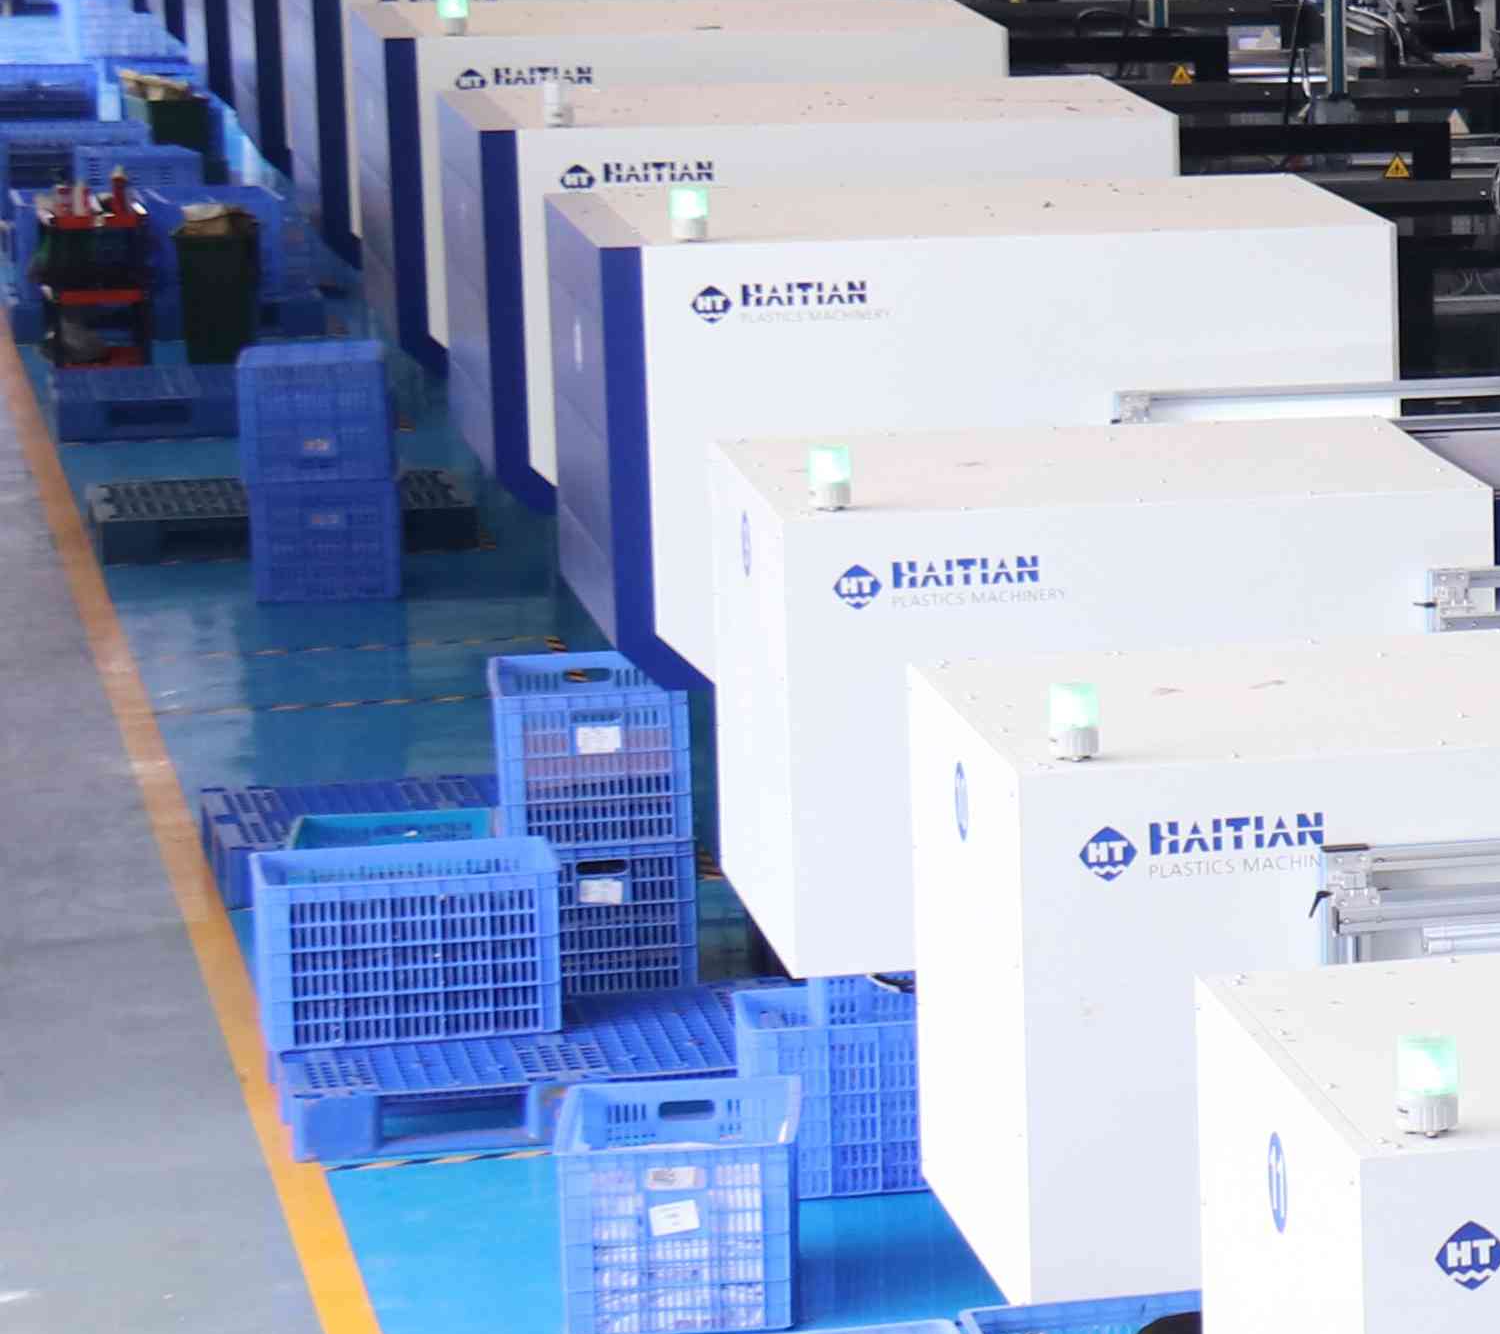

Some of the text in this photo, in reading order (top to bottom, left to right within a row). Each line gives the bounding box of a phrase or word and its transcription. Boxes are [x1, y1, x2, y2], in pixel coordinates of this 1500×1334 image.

[602, 161, 714, 184] HAITIAN
[740, 280, 867, 307] HAITIAN
[892, 555, 1040, 590] HAITIAN
[892, 587, 1066, 608] PLASTICS MACHINERY
[1149, 812, 1325, 856] HAITIAN
[1149, 853, 1321, 879] PLASTICS MACHIN
